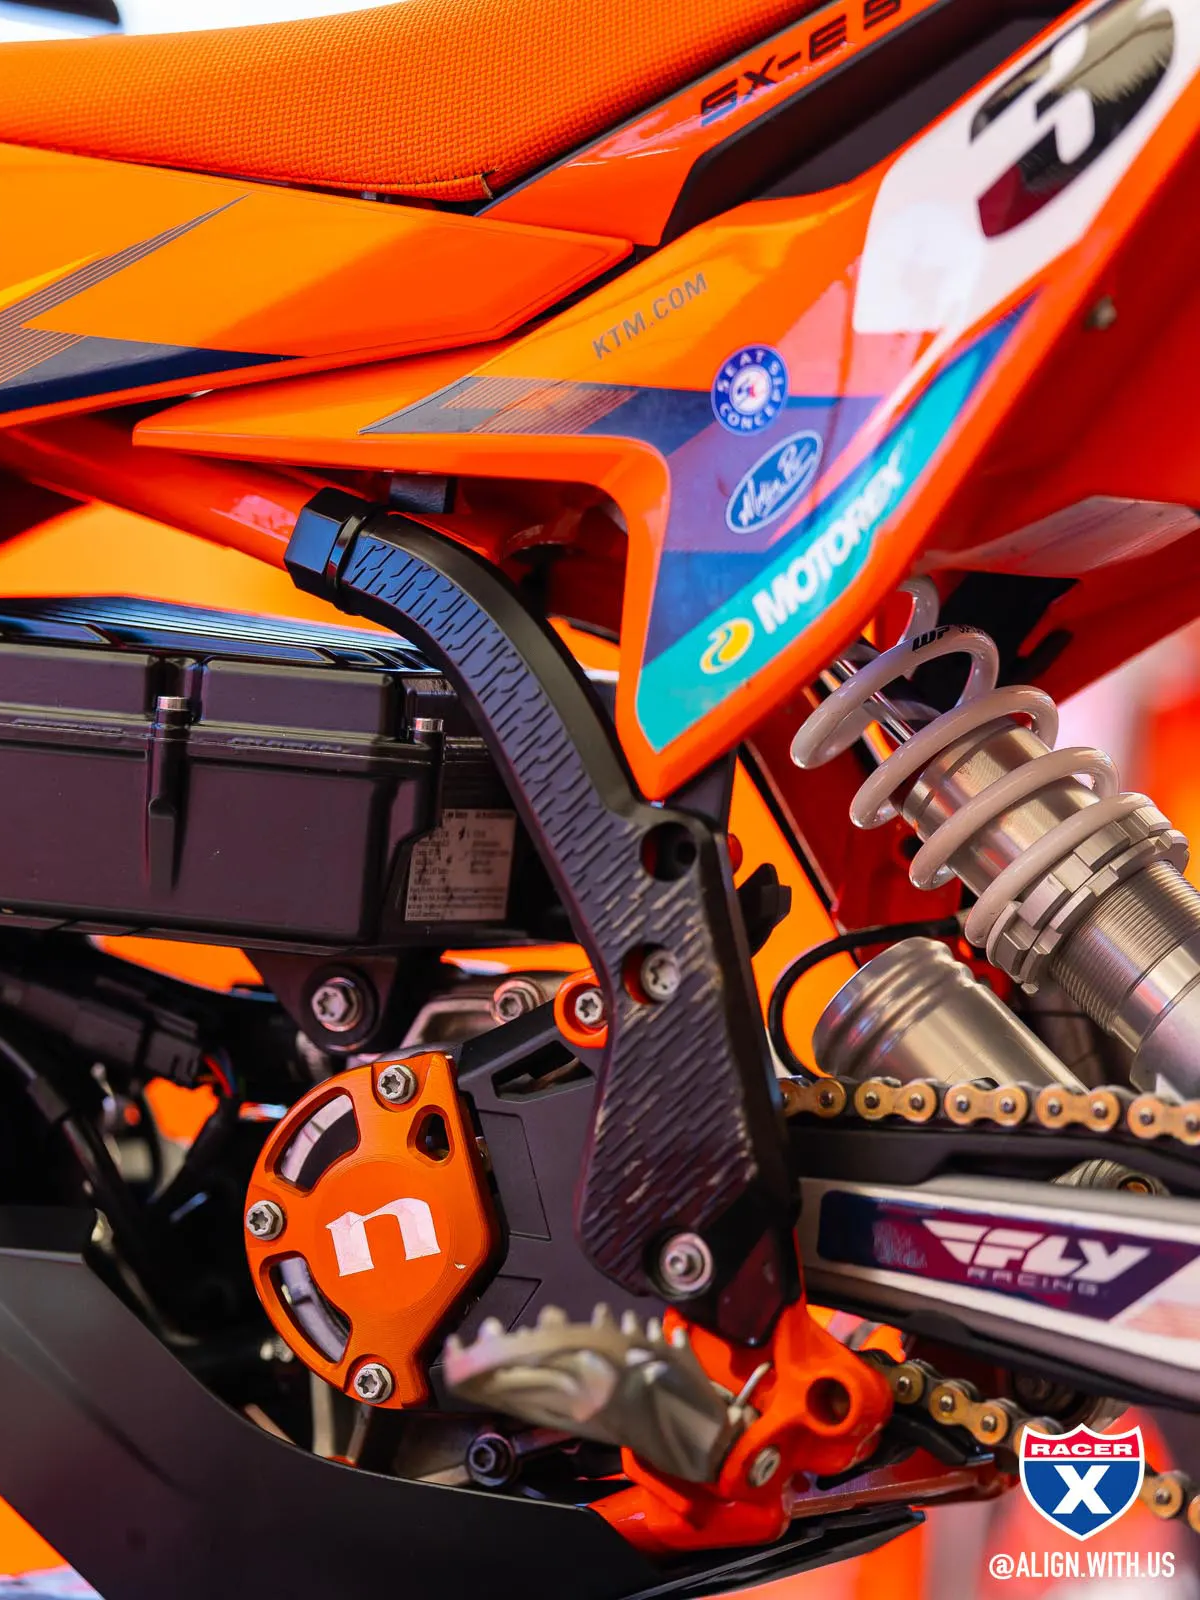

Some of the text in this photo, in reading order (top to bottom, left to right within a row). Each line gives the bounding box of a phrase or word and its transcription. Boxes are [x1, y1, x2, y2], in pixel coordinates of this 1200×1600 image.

[592, 271, 707, 360] KTM.COM
[752, 440, 905, 635] MOTOREX
[921, 1219, 1152, 1283] FLY
[968, 1267, 1100, 1297] RACING
